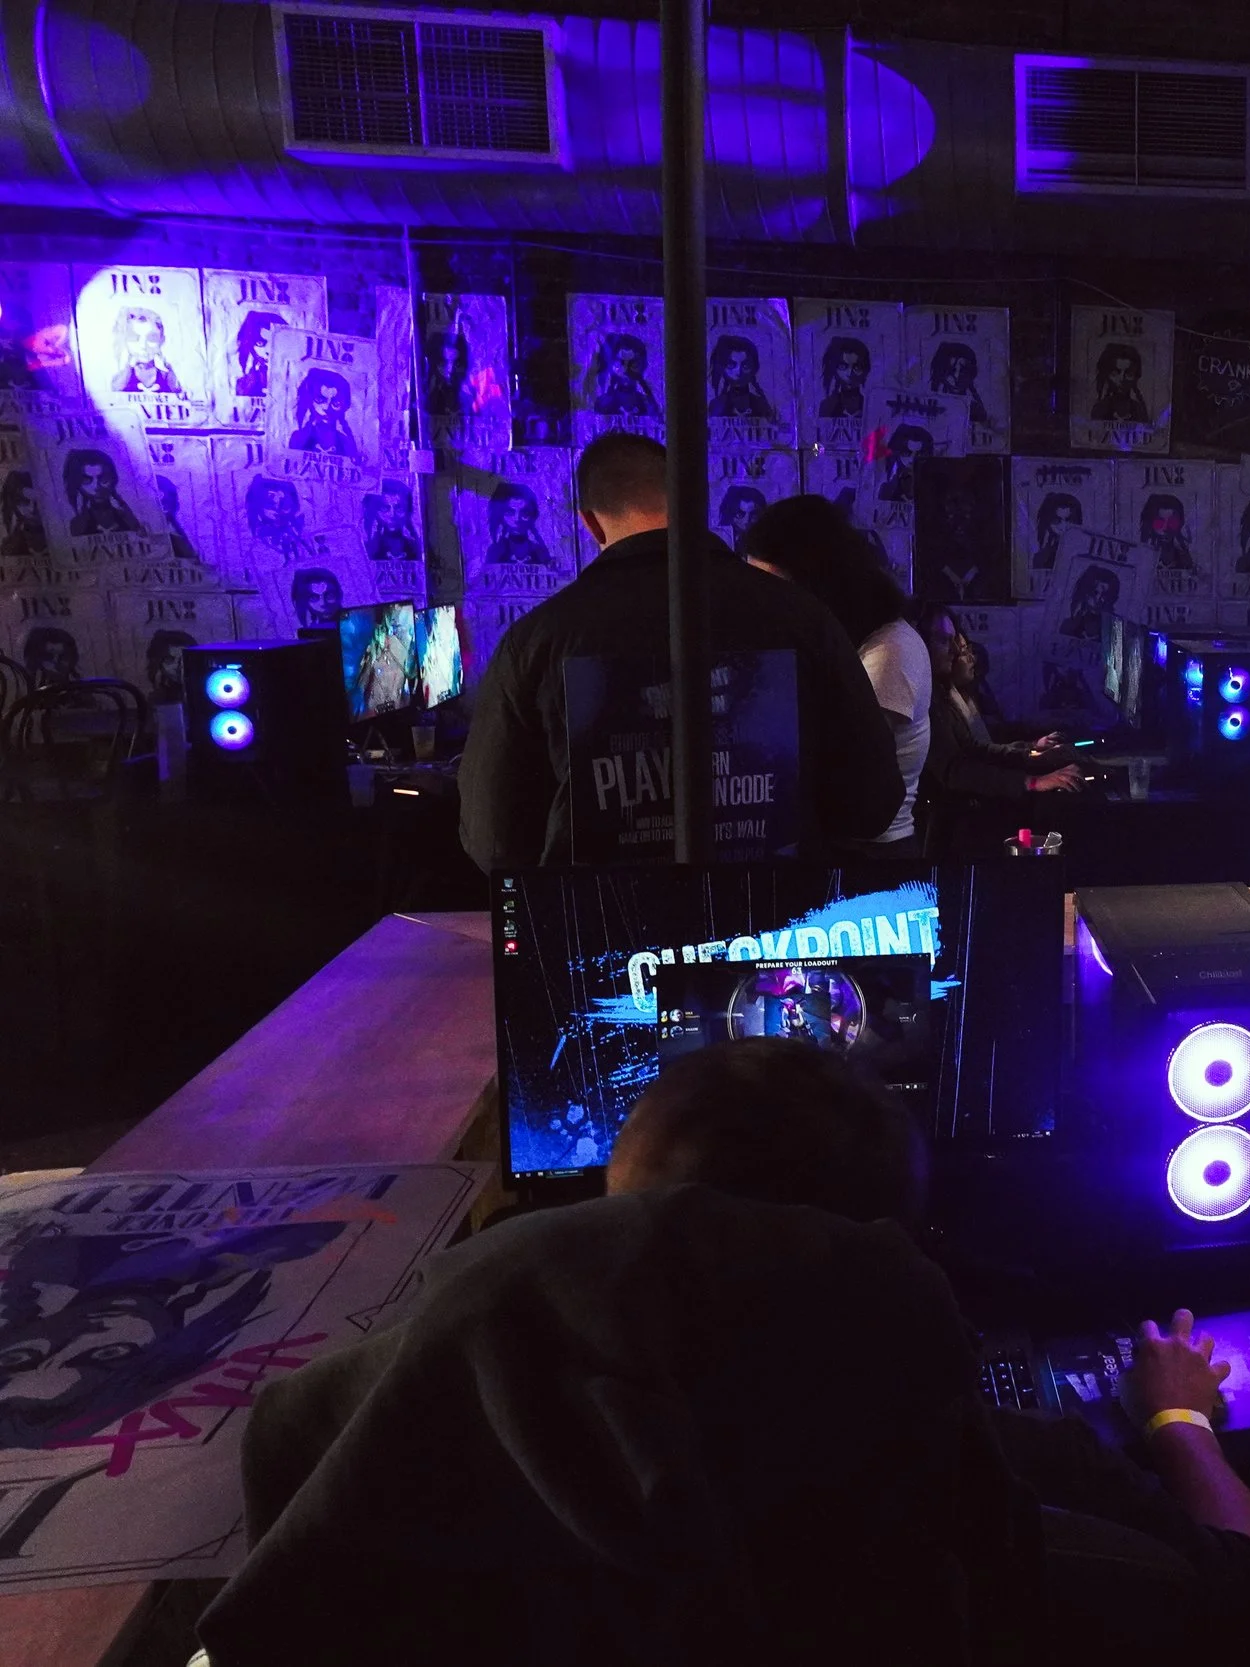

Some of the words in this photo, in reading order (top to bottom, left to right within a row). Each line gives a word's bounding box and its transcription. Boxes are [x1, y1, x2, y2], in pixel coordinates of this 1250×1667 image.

[111, 273, 161, 296] JINX
[238, 278, 291, 305] JINX
[710, 305, 757, 331] JINX
[824, 306, 870, 332] JINX
[931, 313, 978, 337] JINX
[1100, 314, 1144, 339] JINX
[300, 335, 355, 364] JINX
[1142, 466, 1185, 490] JINX
[20, 596, 72, 623] JINX
[146, 600, 197, 625] JINX
[730, 773, 776, 806] CODE
[755, 961, 784, 969] PREPARE
[785, 960, 802, 969] YOUR
[803, 959, 838, 968] LOADOUT!
[791, 967, 802, 975] 63
